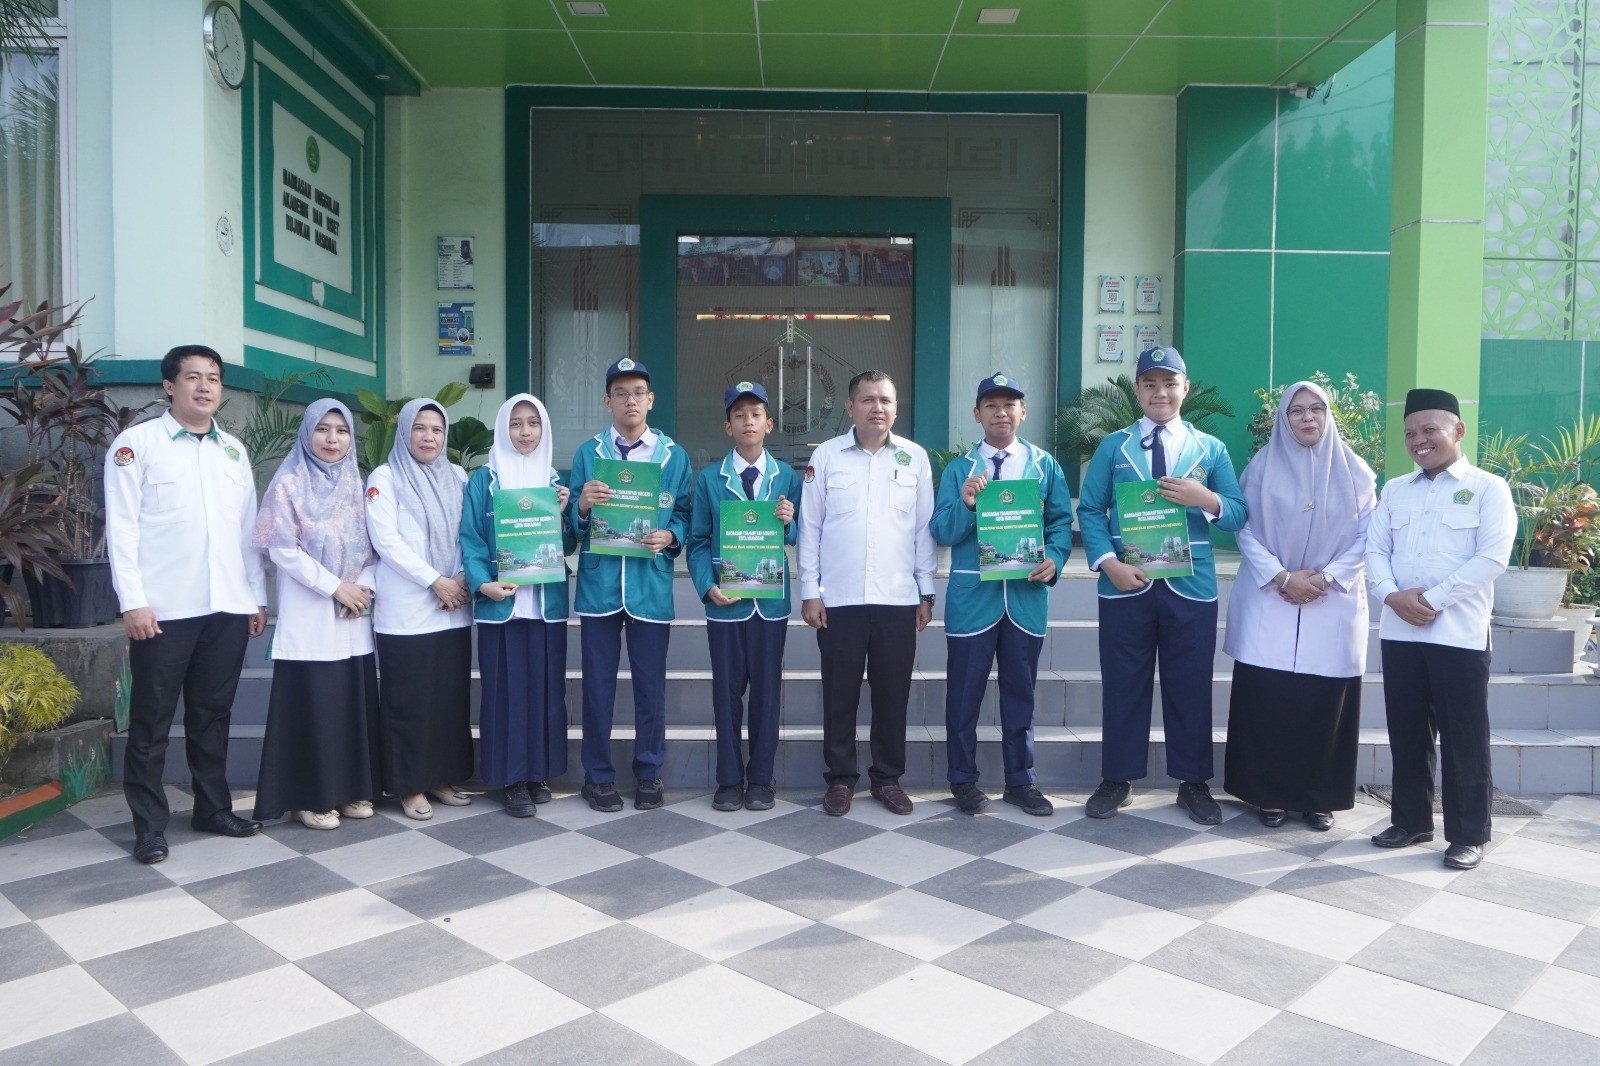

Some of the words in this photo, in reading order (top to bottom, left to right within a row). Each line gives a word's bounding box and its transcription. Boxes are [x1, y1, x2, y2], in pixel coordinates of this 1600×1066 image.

[282, 168, 312, 200] MADRASAH
[314, 188, 340, 216] UNGGULAN
[286, 214, 310, 242] RUJUKAN
[314, 228, 338, 256] NASIONAL
[312, 206, 322, 228] DAN
[326, 216, 340, 236] RISET
